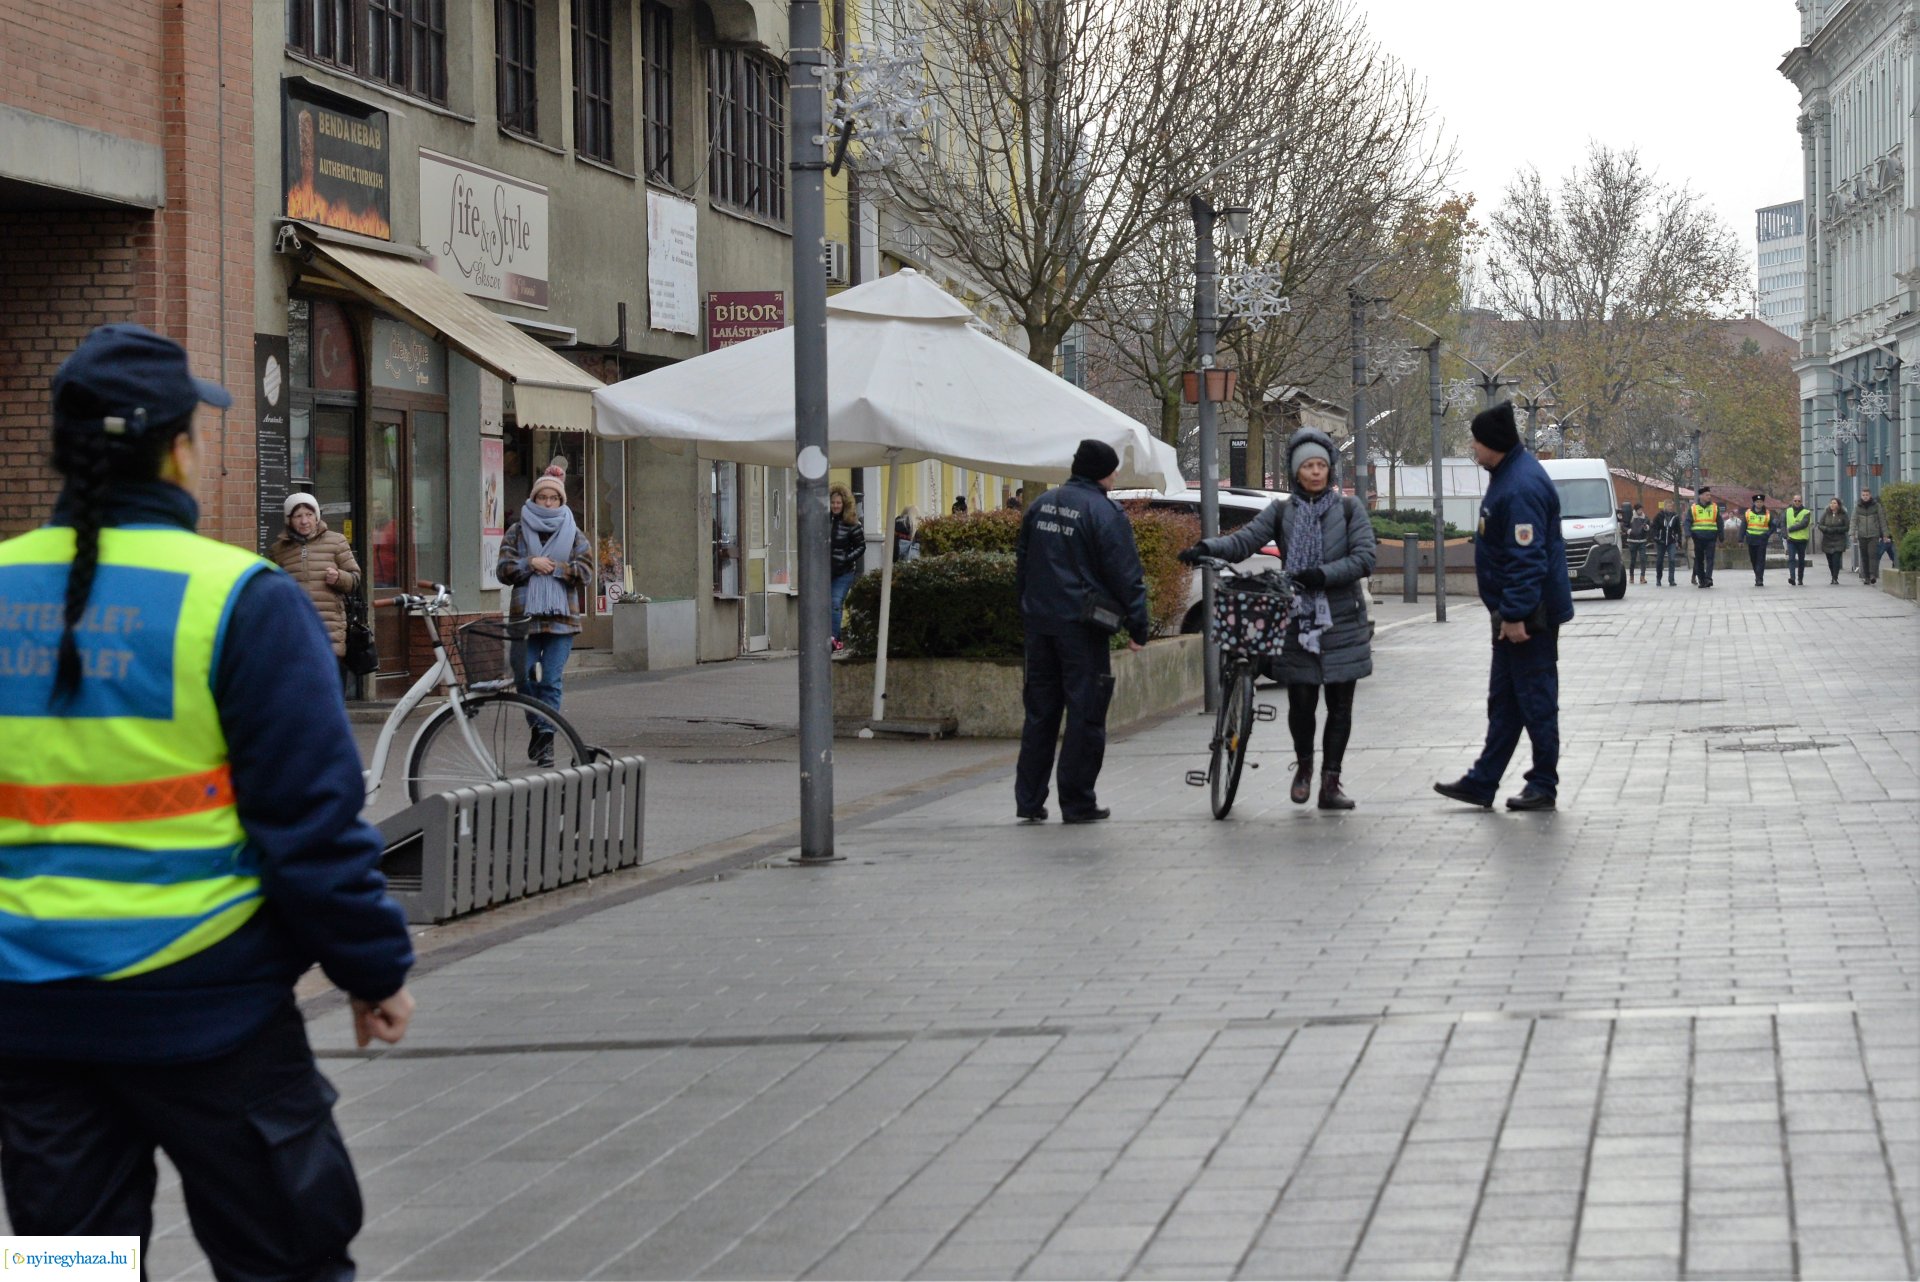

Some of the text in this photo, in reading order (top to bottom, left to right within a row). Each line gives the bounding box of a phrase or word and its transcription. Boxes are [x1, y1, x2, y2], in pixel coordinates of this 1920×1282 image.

[319, 111, 381, 149] BENDA KEBAB
[319, 157, 384, 189] AUTHENTIC TURKISH
[443, 173, 480, 278] Life
[490, 184, 530, 267] Style
[714, 301, 779, 322] BÍBOR
